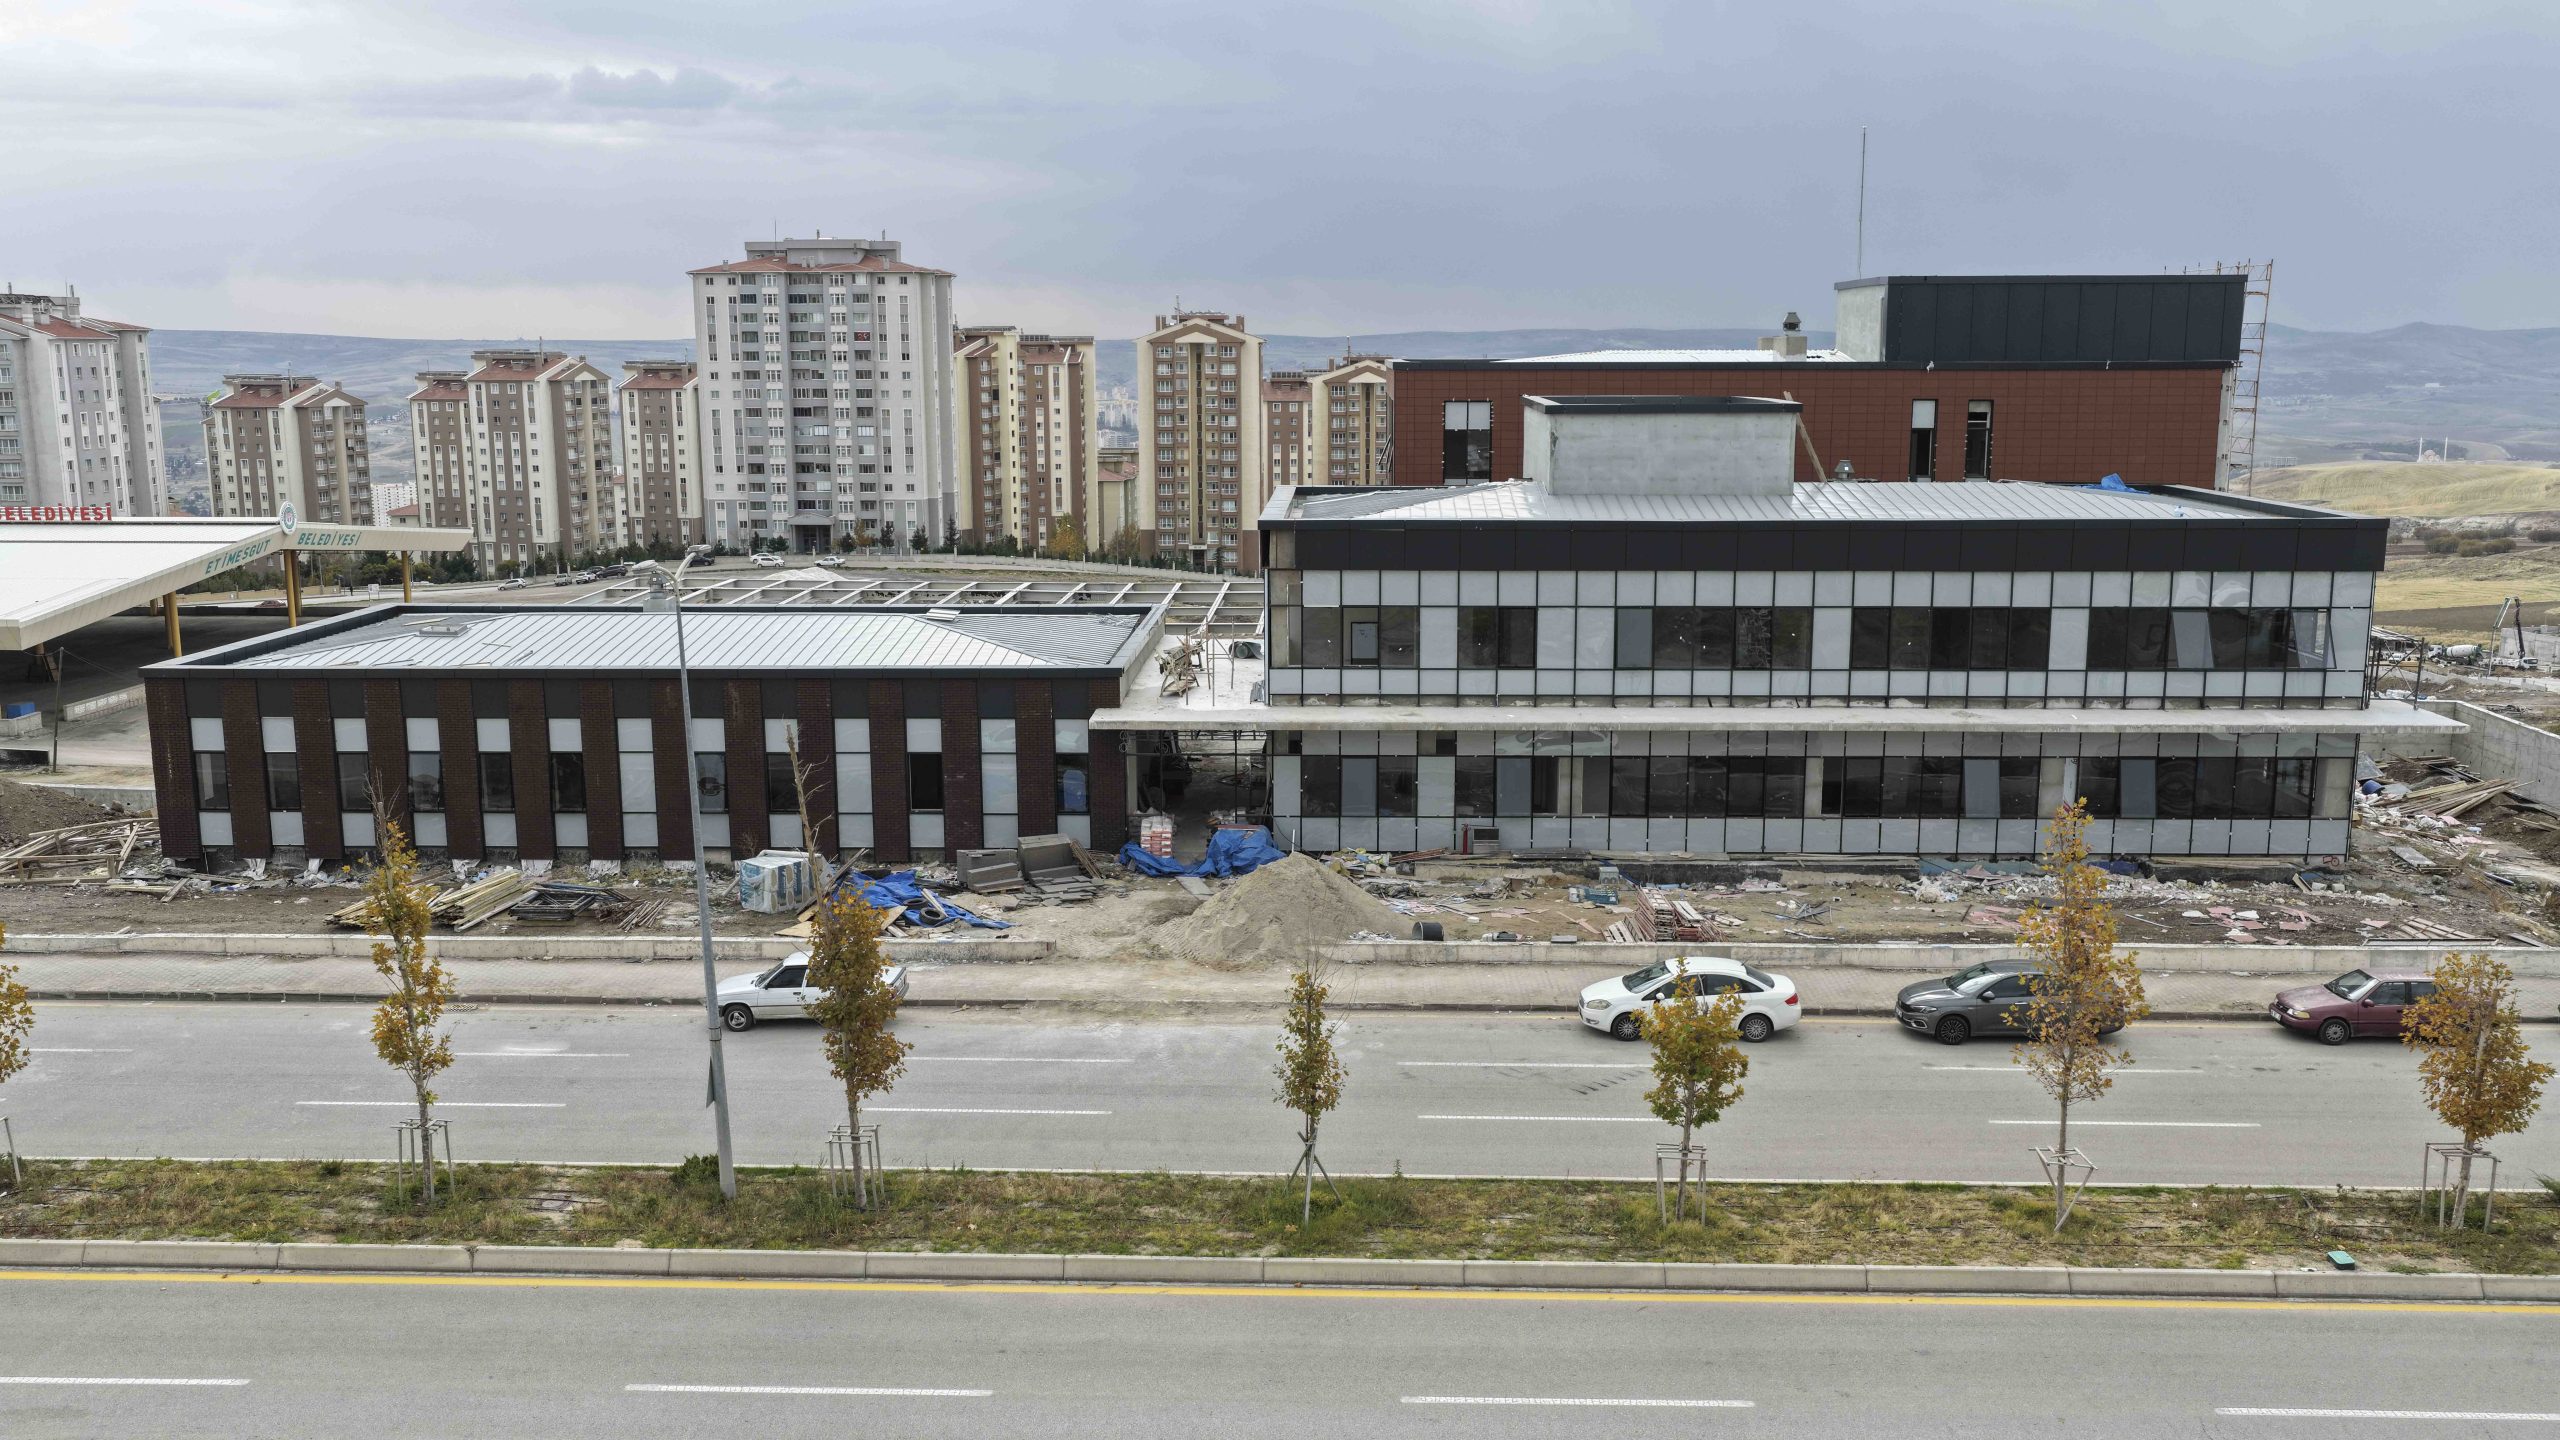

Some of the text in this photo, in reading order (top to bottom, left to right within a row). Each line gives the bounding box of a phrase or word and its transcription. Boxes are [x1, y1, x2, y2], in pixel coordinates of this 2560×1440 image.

[0, 502, 112, 521] ELEDİYESİ
[205, 531, 362, 575] ETİMESGUT BELEDİYESİ
